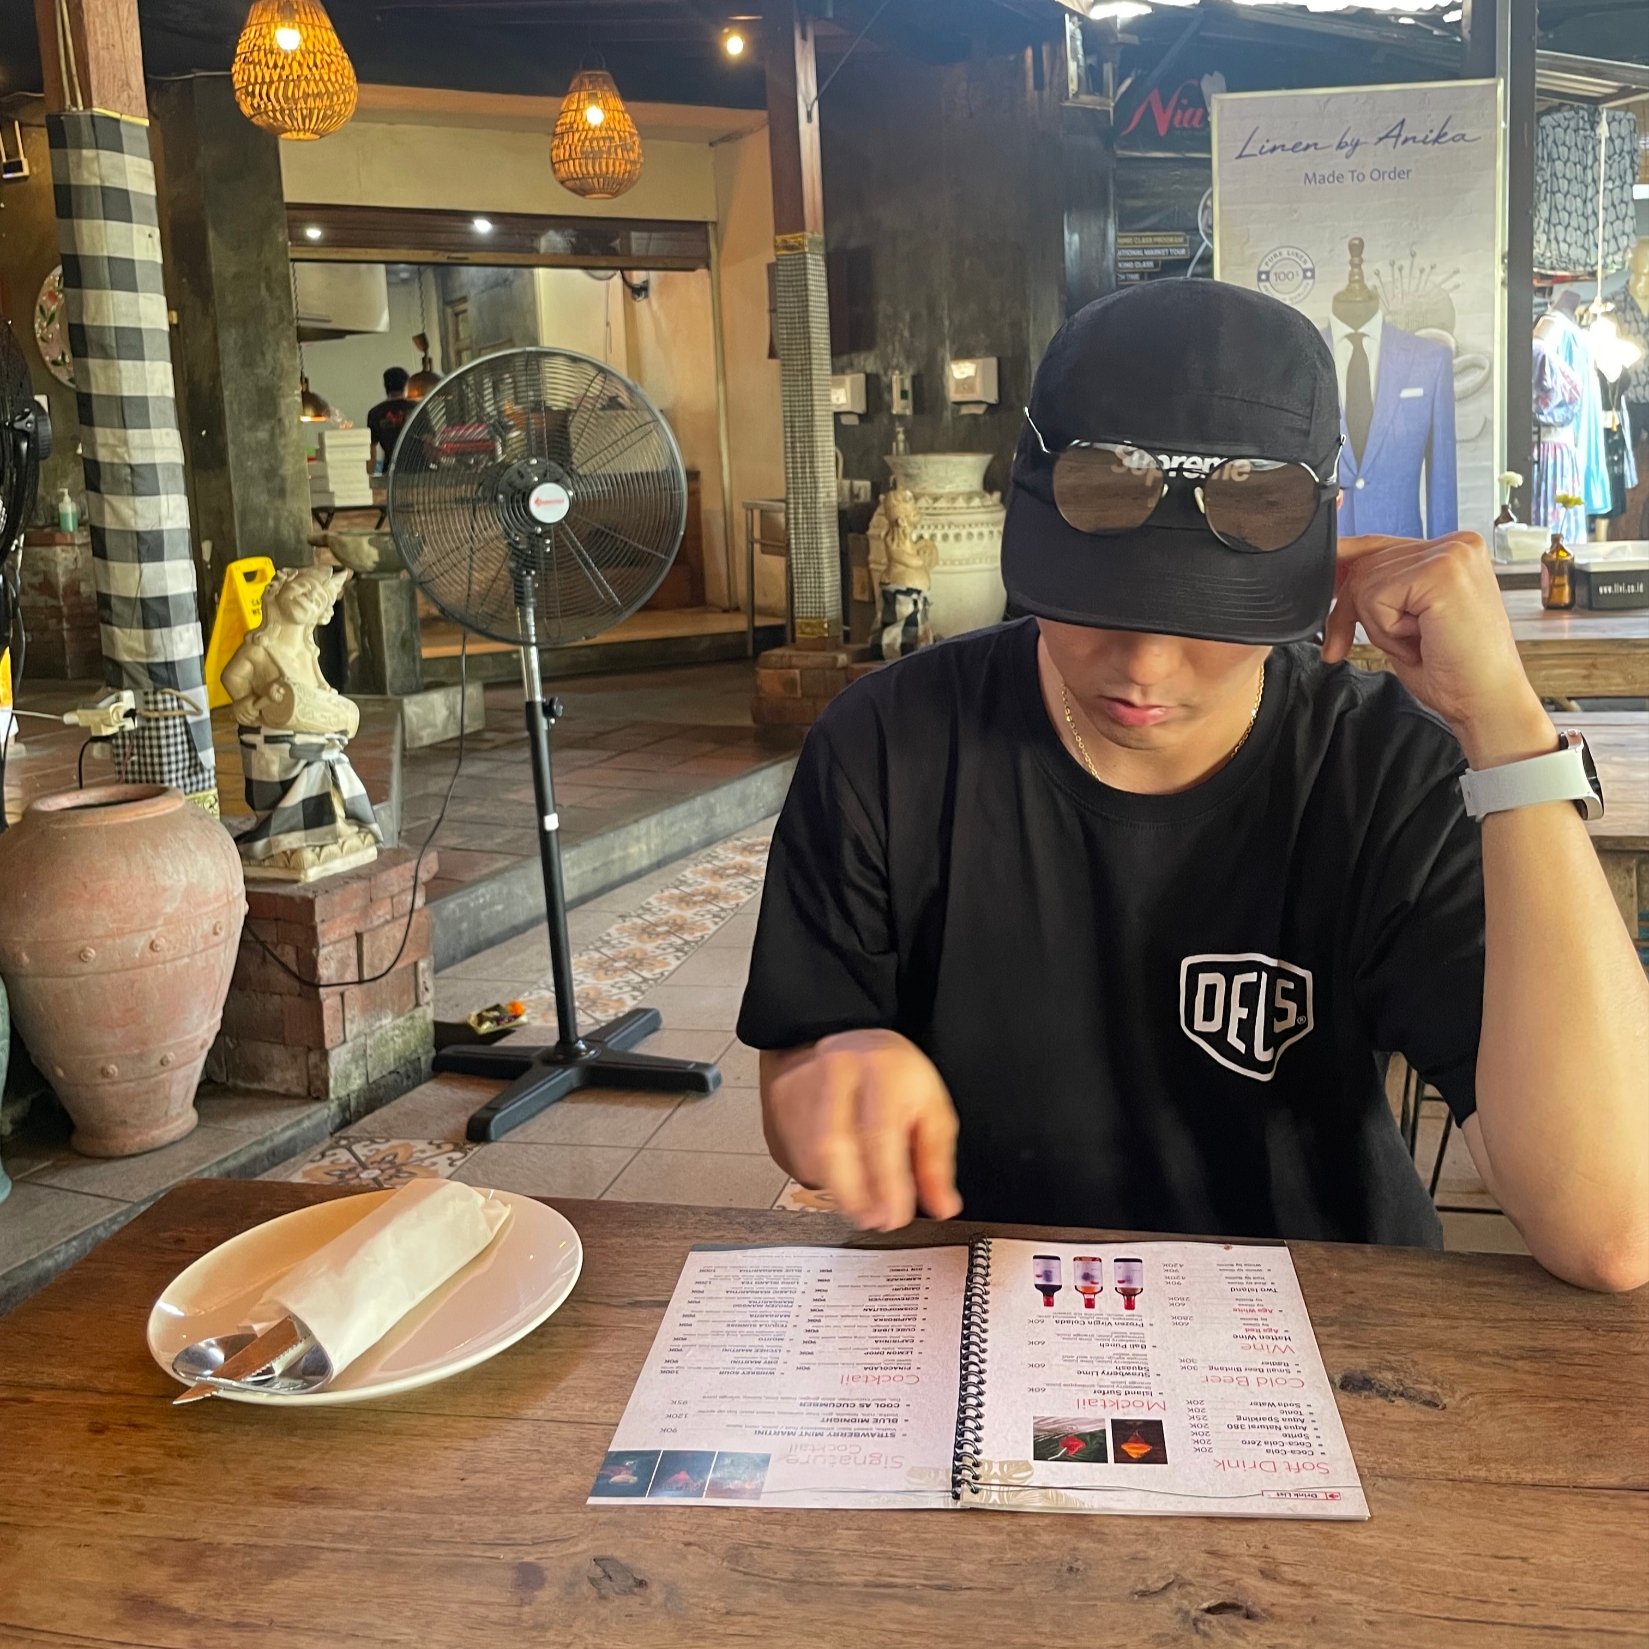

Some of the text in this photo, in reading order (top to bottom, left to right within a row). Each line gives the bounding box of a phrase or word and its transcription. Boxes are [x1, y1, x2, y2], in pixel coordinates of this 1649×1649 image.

[1235, 115, 1482, 160] Linen by Anika
[1304, 167, 1412, 185] Made To Order
[1264, 250, 1309, 267] PURE LINEN
[1240, 1343, 1295, 1354] Wine
[840, 1374, 920, 1385] Cocktail
[1100, 1370, 1150, 1378] Strawberry
[1201, 1375, 1304, 1388] Cold Beer
[1076, 1398, 1166, 1411] Mocktail
[788, 1443, 862, 1454] Cocktail
[785, 1452, 904, 1469] Signature
[1213, 1459, 1329, 1474] Soft Drink
